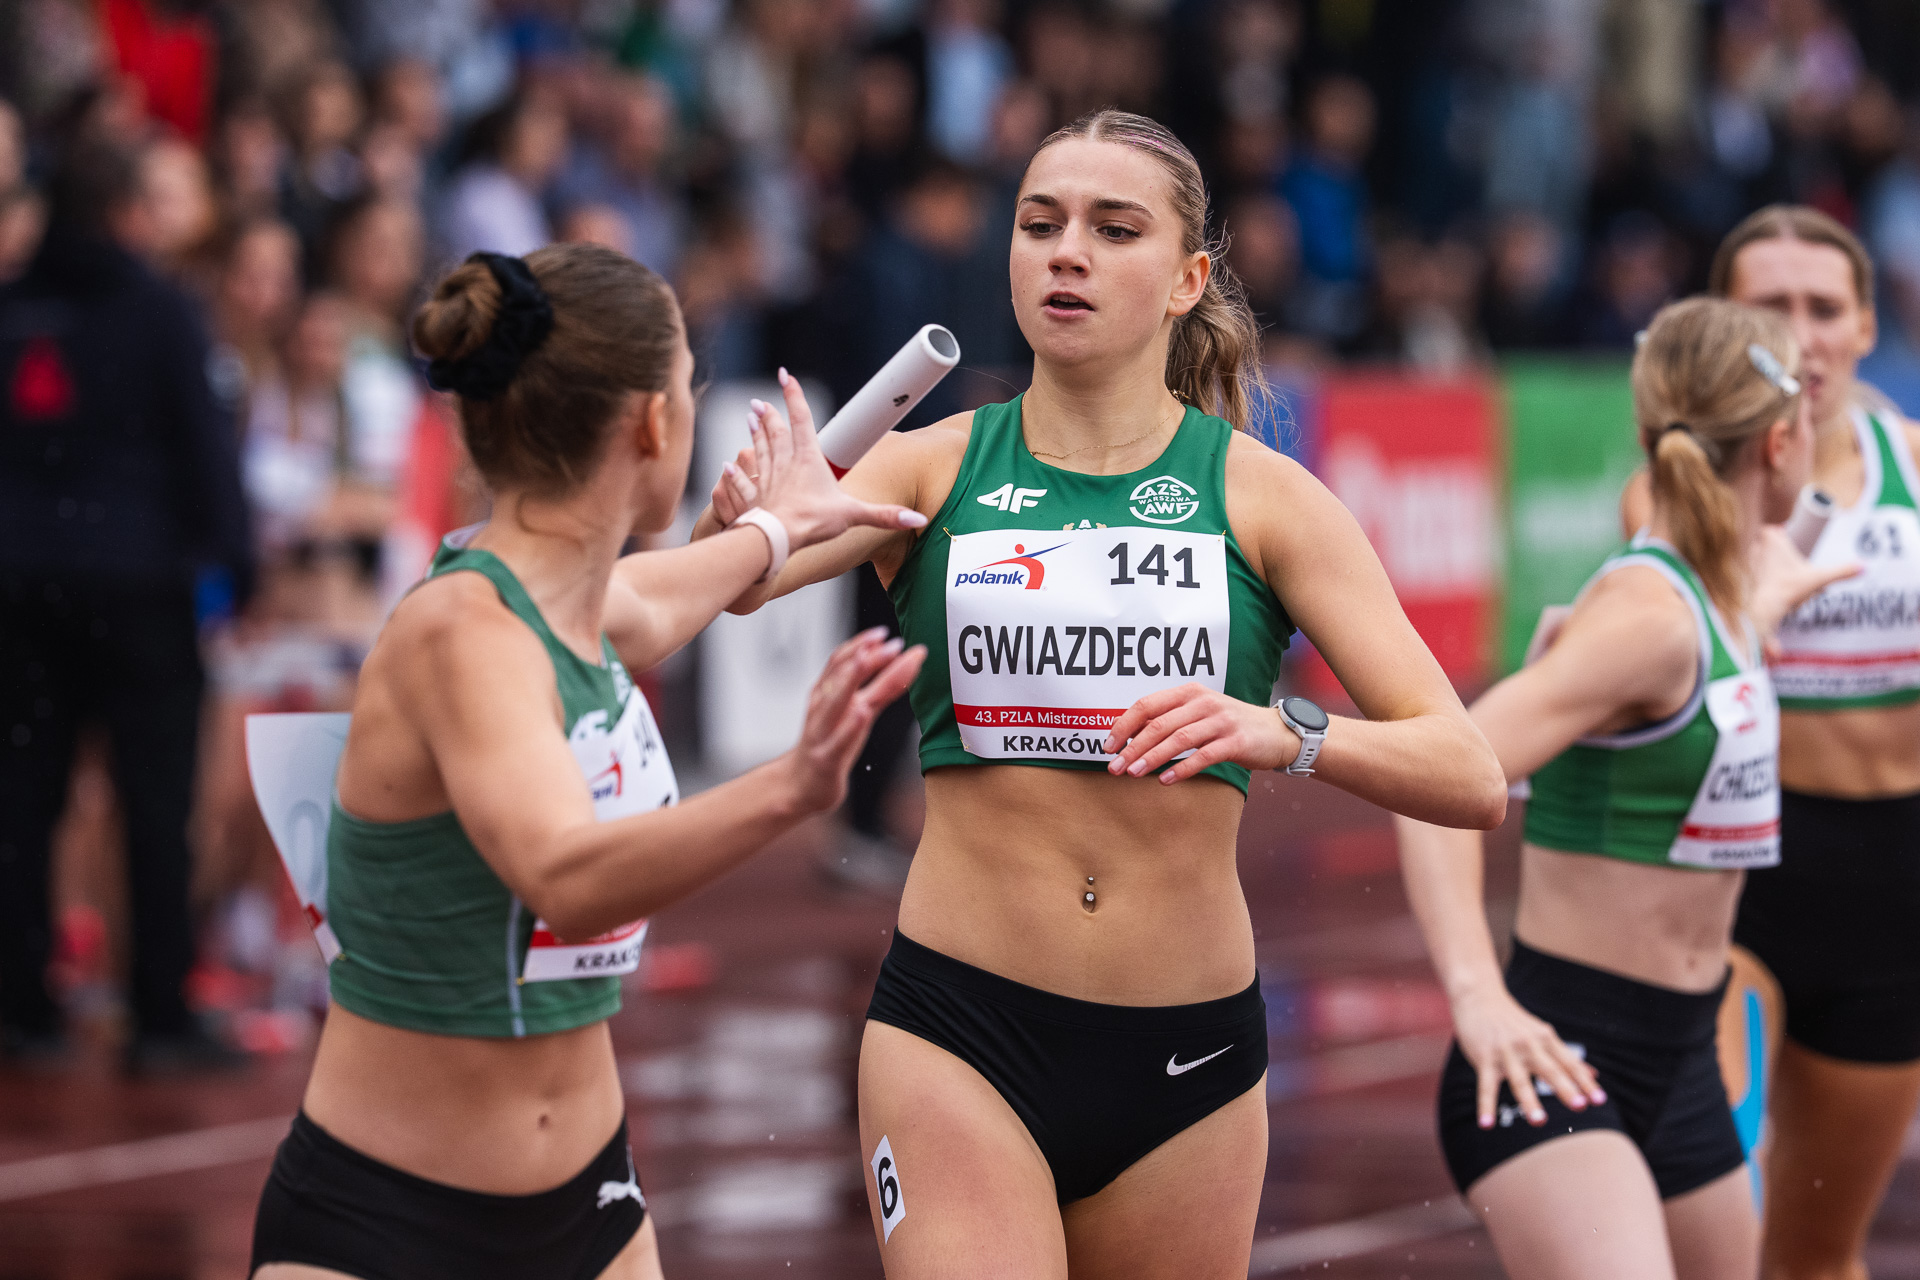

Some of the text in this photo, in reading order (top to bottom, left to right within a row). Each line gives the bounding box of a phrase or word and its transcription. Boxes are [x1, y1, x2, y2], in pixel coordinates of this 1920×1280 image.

[976, 483, 1048, 514] 4F
[1144, 483, 1182, 497] AZS
[1138, 496, 1191, 505] WARSZAWA
[1143, 501, 1188, 516] AWF
[1107, 542, 1201, 589] 141
[954, 569, 1025, 588] polanik
[957, 624, 1216, 677] GWIAZDECKA
[974, 711, 1115, 726] 43. PZLA Mistrzostw
[1003, 733, 1107, 755] KRAKÓW
[878, 1156, 898, 1219] 6
